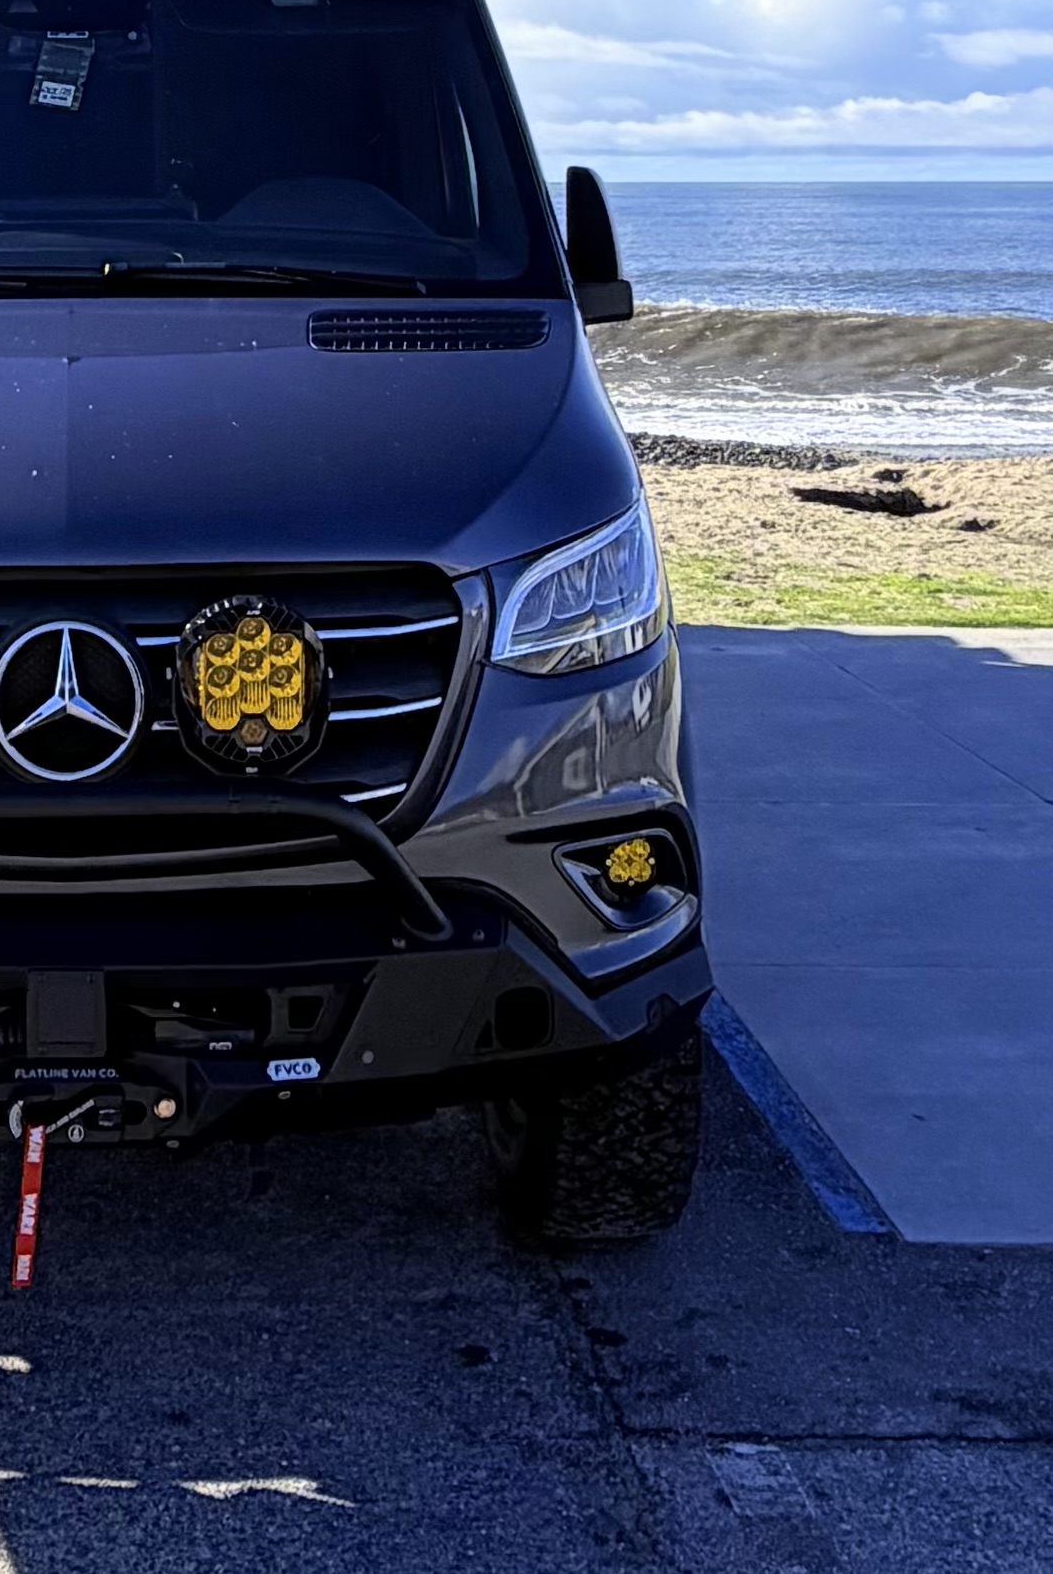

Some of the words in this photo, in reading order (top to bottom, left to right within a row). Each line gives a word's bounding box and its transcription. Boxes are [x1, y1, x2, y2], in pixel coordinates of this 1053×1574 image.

[14, 1068, 69, 1079] FLATLINE
[72, 1068, 96, 1079] VAN
[98, 1068, 120, 1079] CO.
[274, 1062, 313, 1078] FVCO
